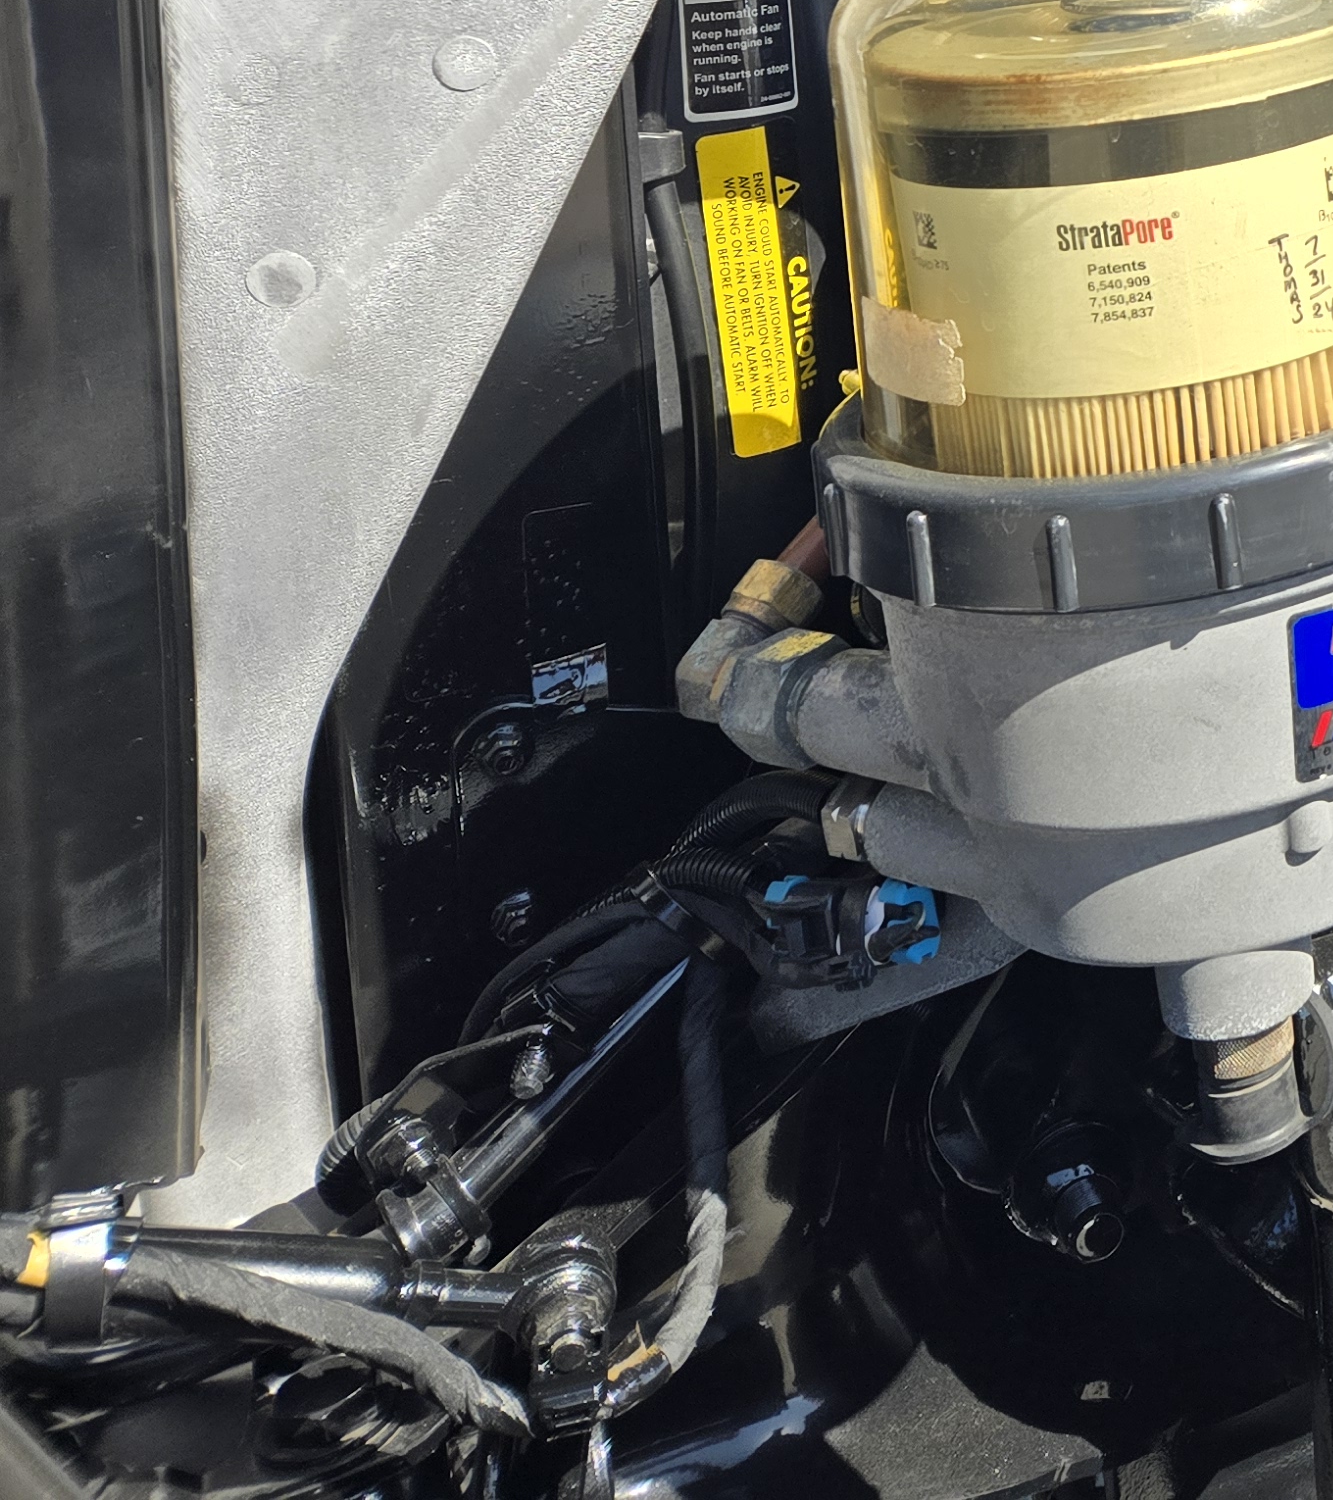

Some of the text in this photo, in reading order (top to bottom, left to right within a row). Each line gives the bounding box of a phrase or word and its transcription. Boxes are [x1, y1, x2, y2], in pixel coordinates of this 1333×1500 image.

[691, 4, 779, 23] Automatic Fan
[692, 22, 782, 41] Keep hands clear
[692, 35, 773, 53] when engine is
[693, 54, 741, 66] running.
[694, 63, 790, 83] Fan starts or stops
[694, 82, 745, 97] by itself.
[1087, 260, 1147, 276] Patents
[738, 176, 777, 408] AVOID INJURY, TURN IGNITION OFF WHEN
[753, 171, 790, 404] ENGINE COULD START AUTOMATICALLY. TO
[1087, 275, 1151, 293] 6,540,909
[712, 203, 746, 396] SOUND BEFORE AUTOMATIC START.
[723, 177, 763, 412] WORKING ON FAN OR BELTS. ALARM WILL
[1089, 291, 1153, 309] 7,150,824
[787, 256, 817, 390] CAUTION:
[1090, 306, 1155, 324] 7,854,837
